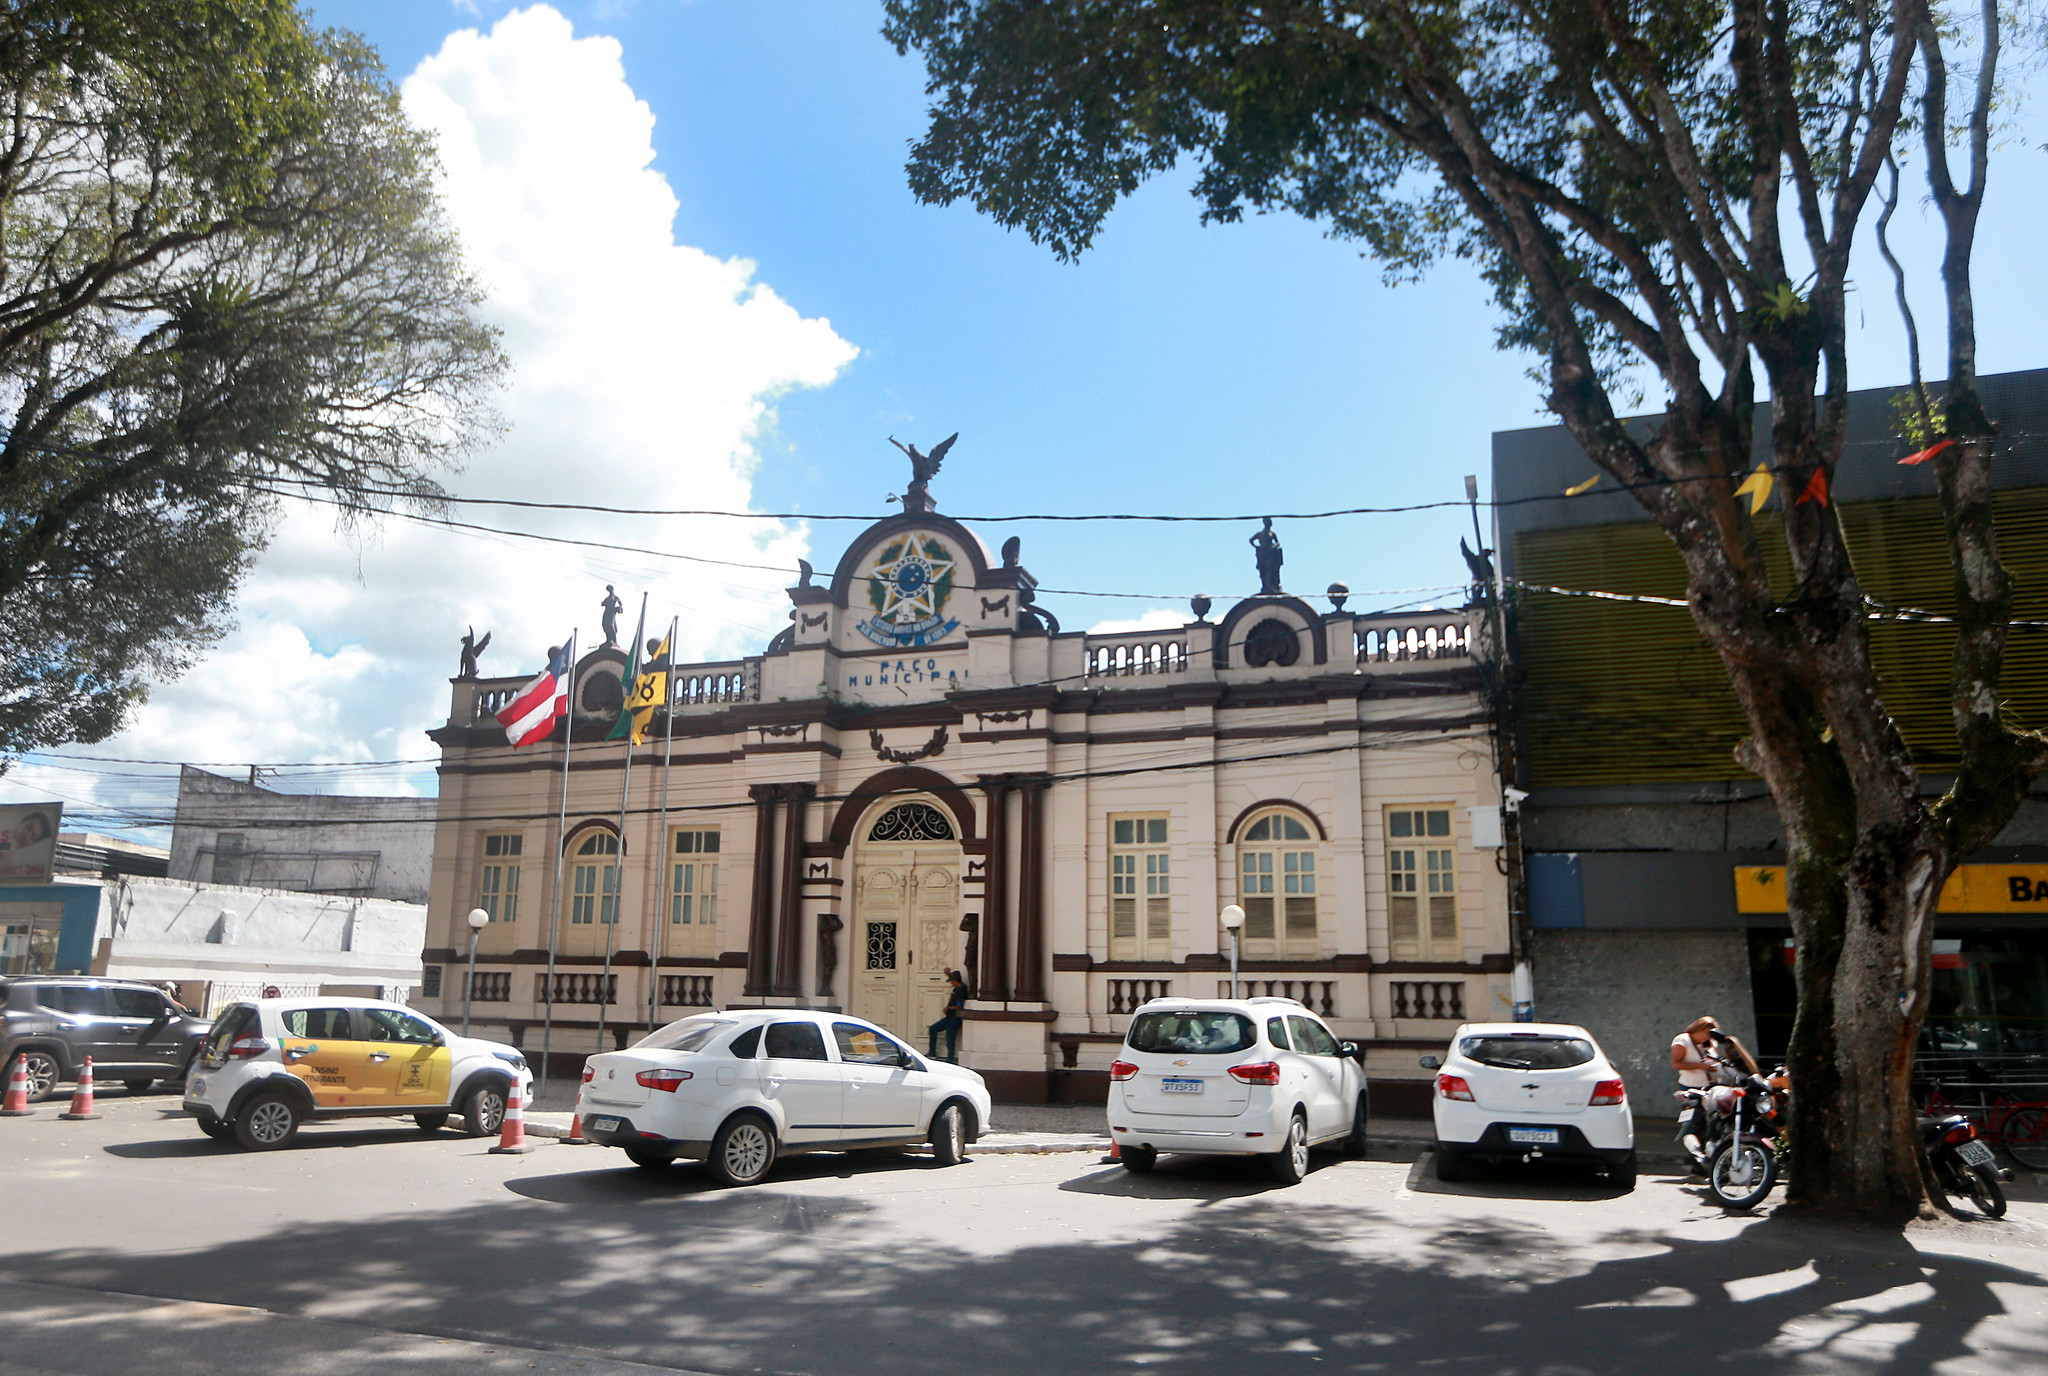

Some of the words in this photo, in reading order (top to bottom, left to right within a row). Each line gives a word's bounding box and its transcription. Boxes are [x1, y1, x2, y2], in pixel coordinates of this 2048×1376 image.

[881, 659, 936, 673] PAÇO
[311, 1066, 339, 1074] ENSINO
[303, 1074, 346, 1083] ITINERANTE
